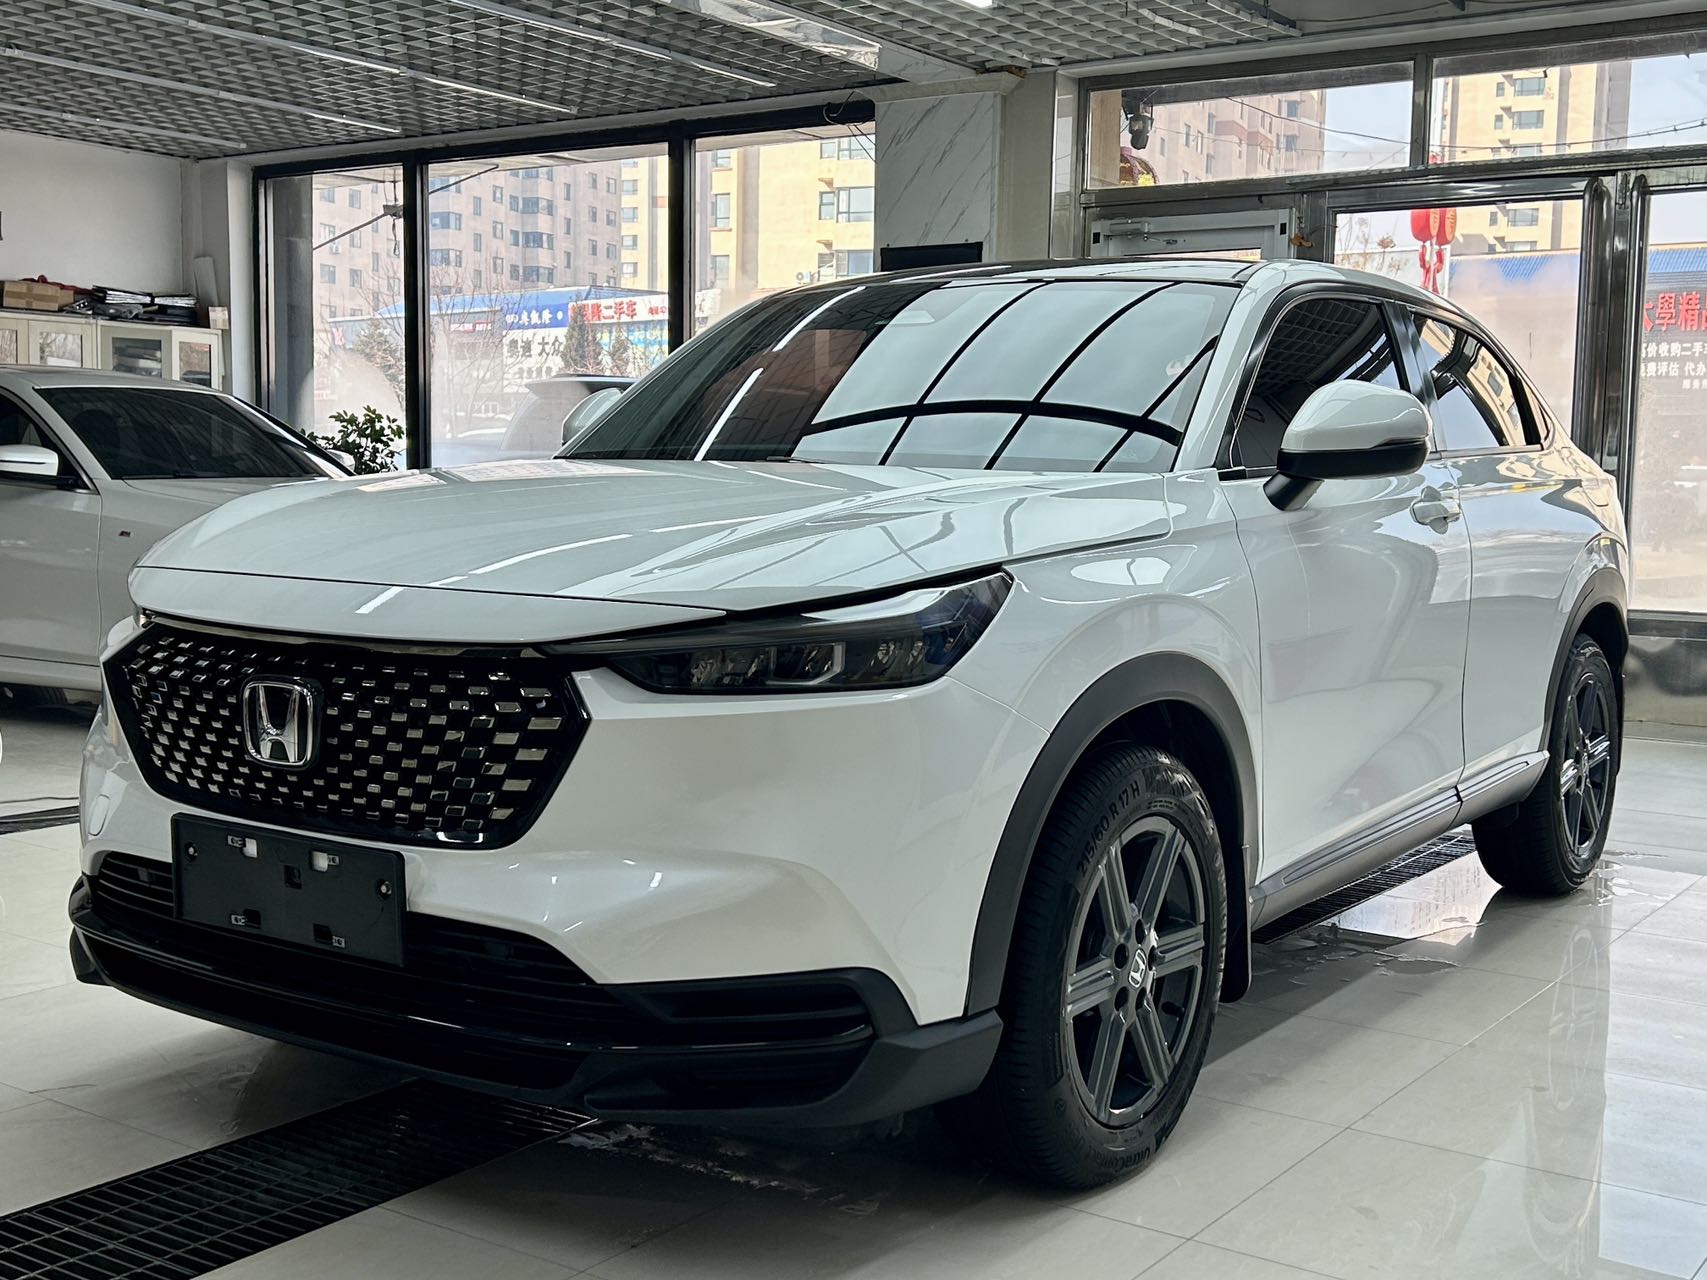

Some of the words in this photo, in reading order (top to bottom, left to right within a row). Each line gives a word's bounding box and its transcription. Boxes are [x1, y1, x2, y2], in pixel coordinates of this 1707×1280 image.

[1076, 815, 1110, 874] 215/60
[1119, 788, 1130, 808] 17
[1130, 780, 1140, 799] H
